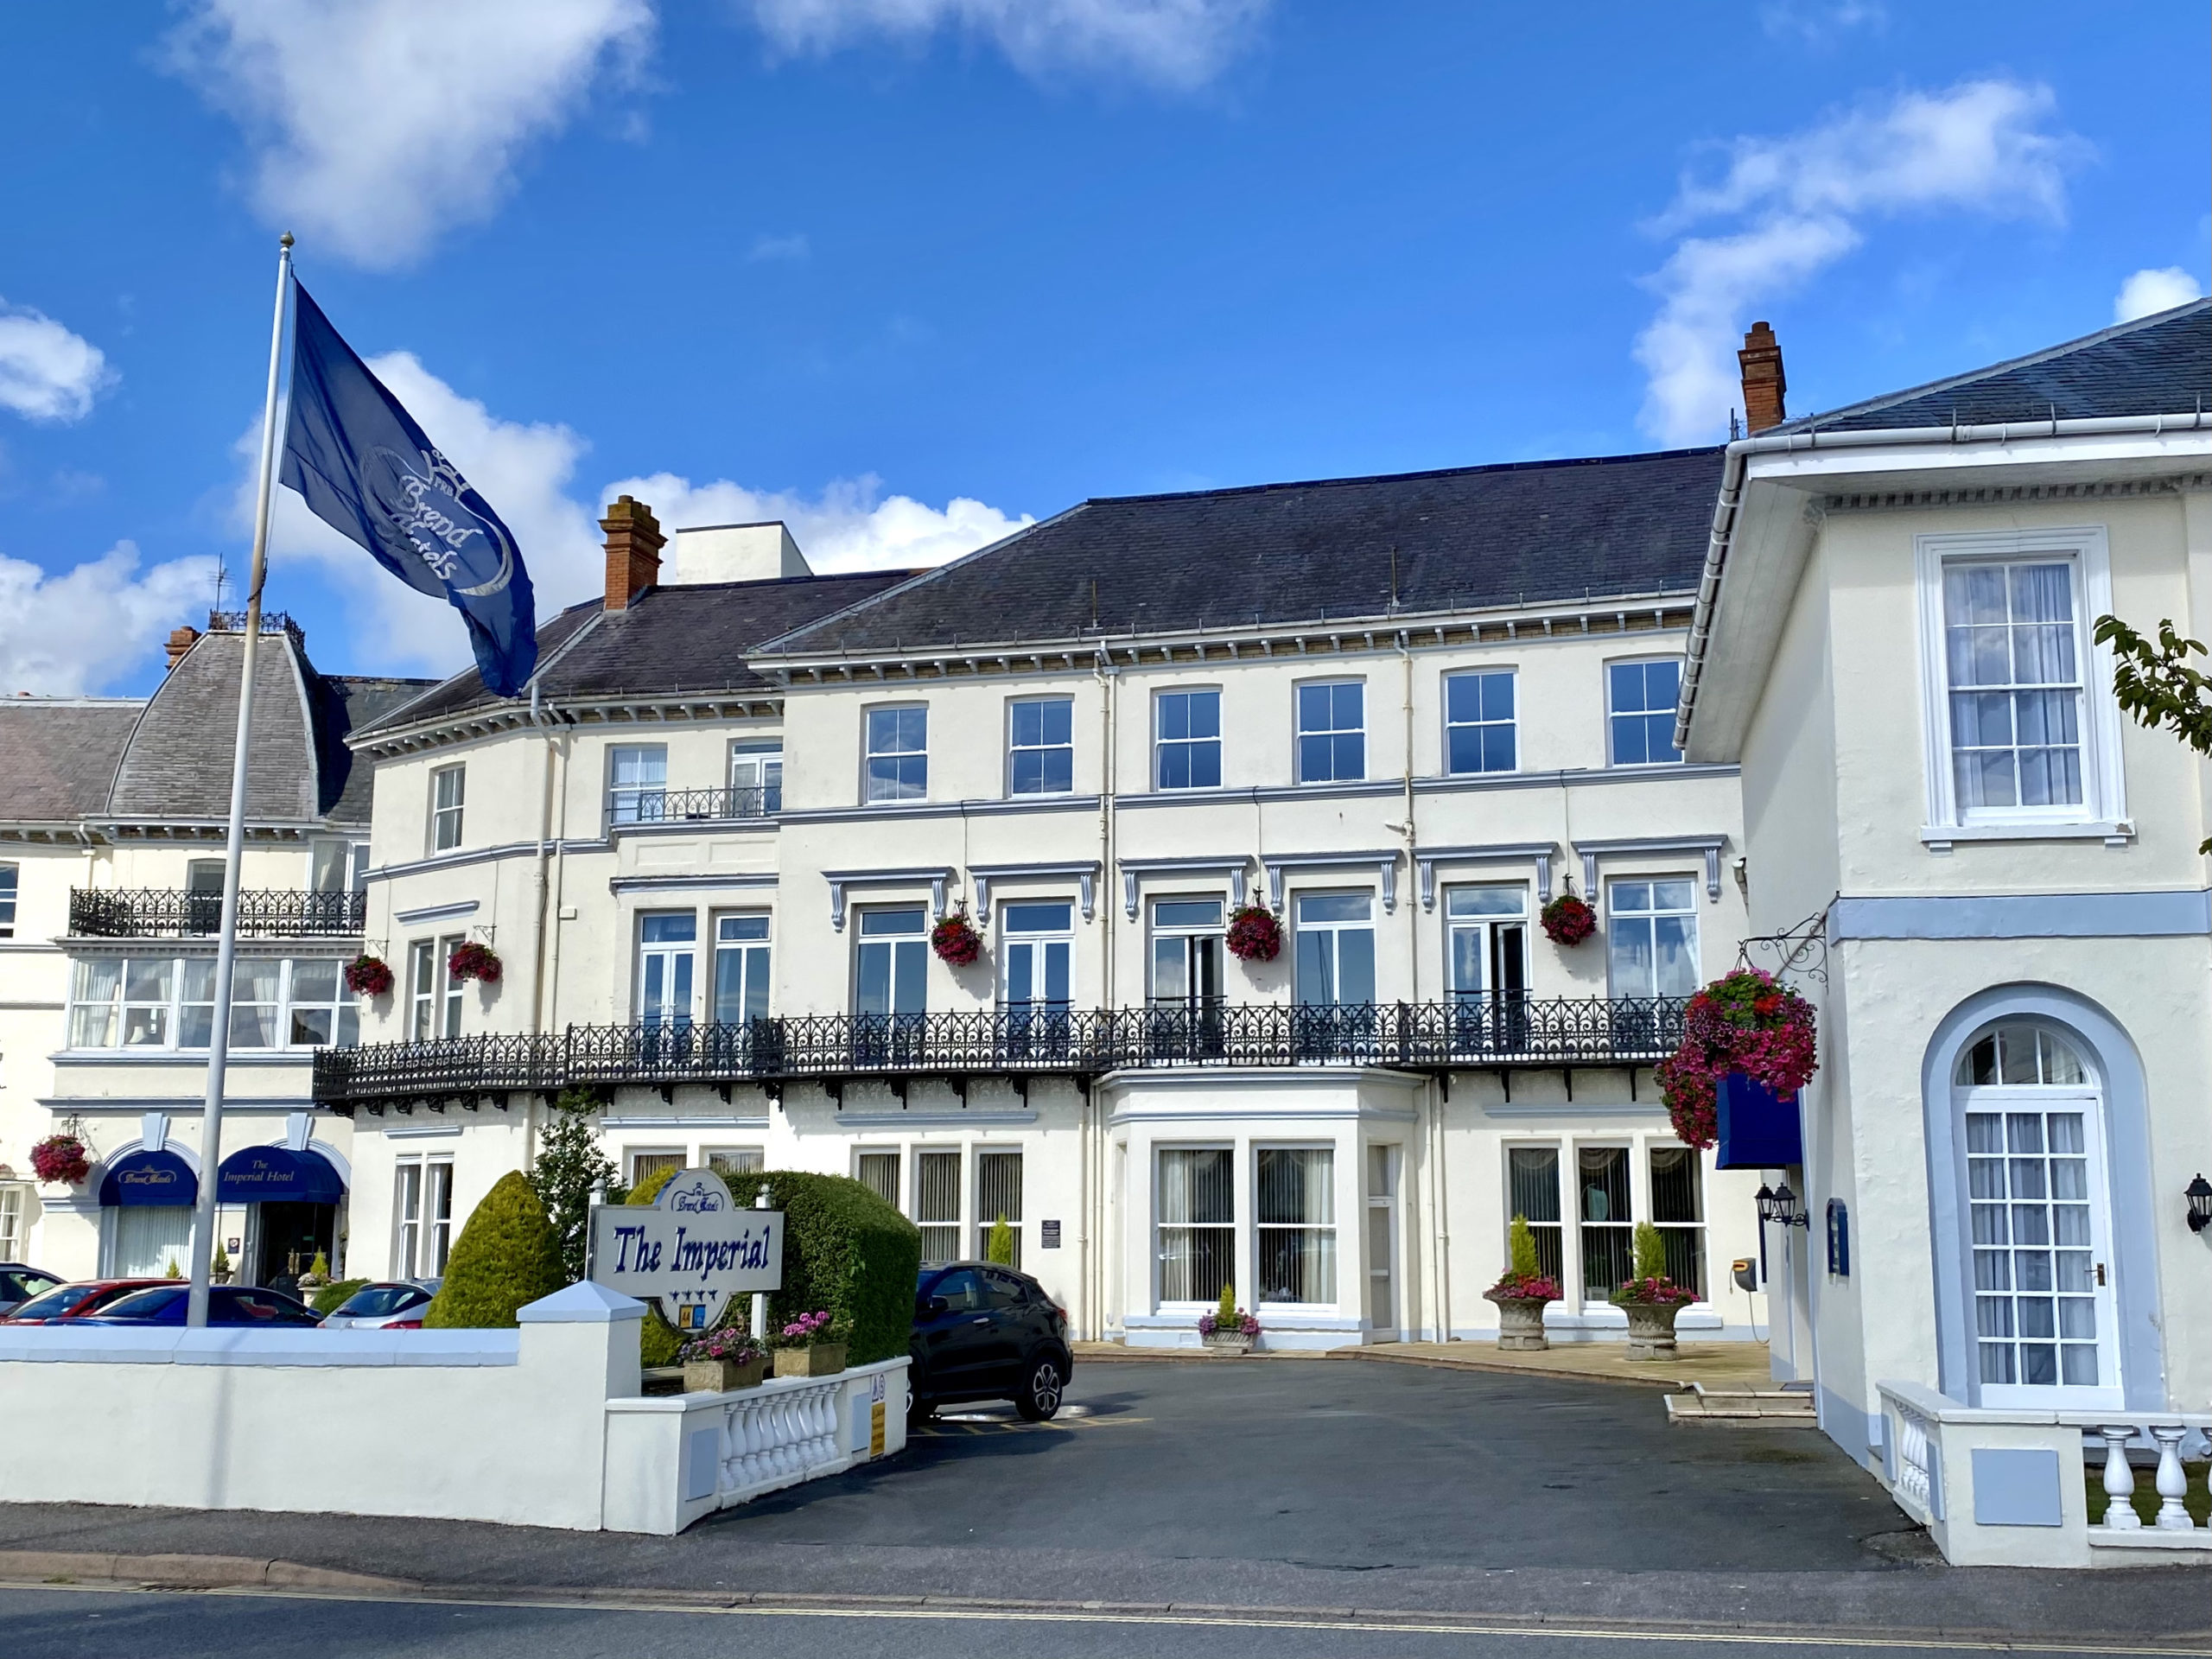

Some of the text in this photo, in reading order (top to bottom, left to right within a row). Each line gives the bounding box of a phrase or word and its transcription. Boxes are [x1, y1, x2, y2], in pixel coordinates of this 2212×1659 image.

[434, 476, 454, 497] PRB
[251, 1160, 269, 1169] The
[224, 1171, 295, 1185] Imperial Hotel
[613, 1224, 771, 1282] The Imperial
